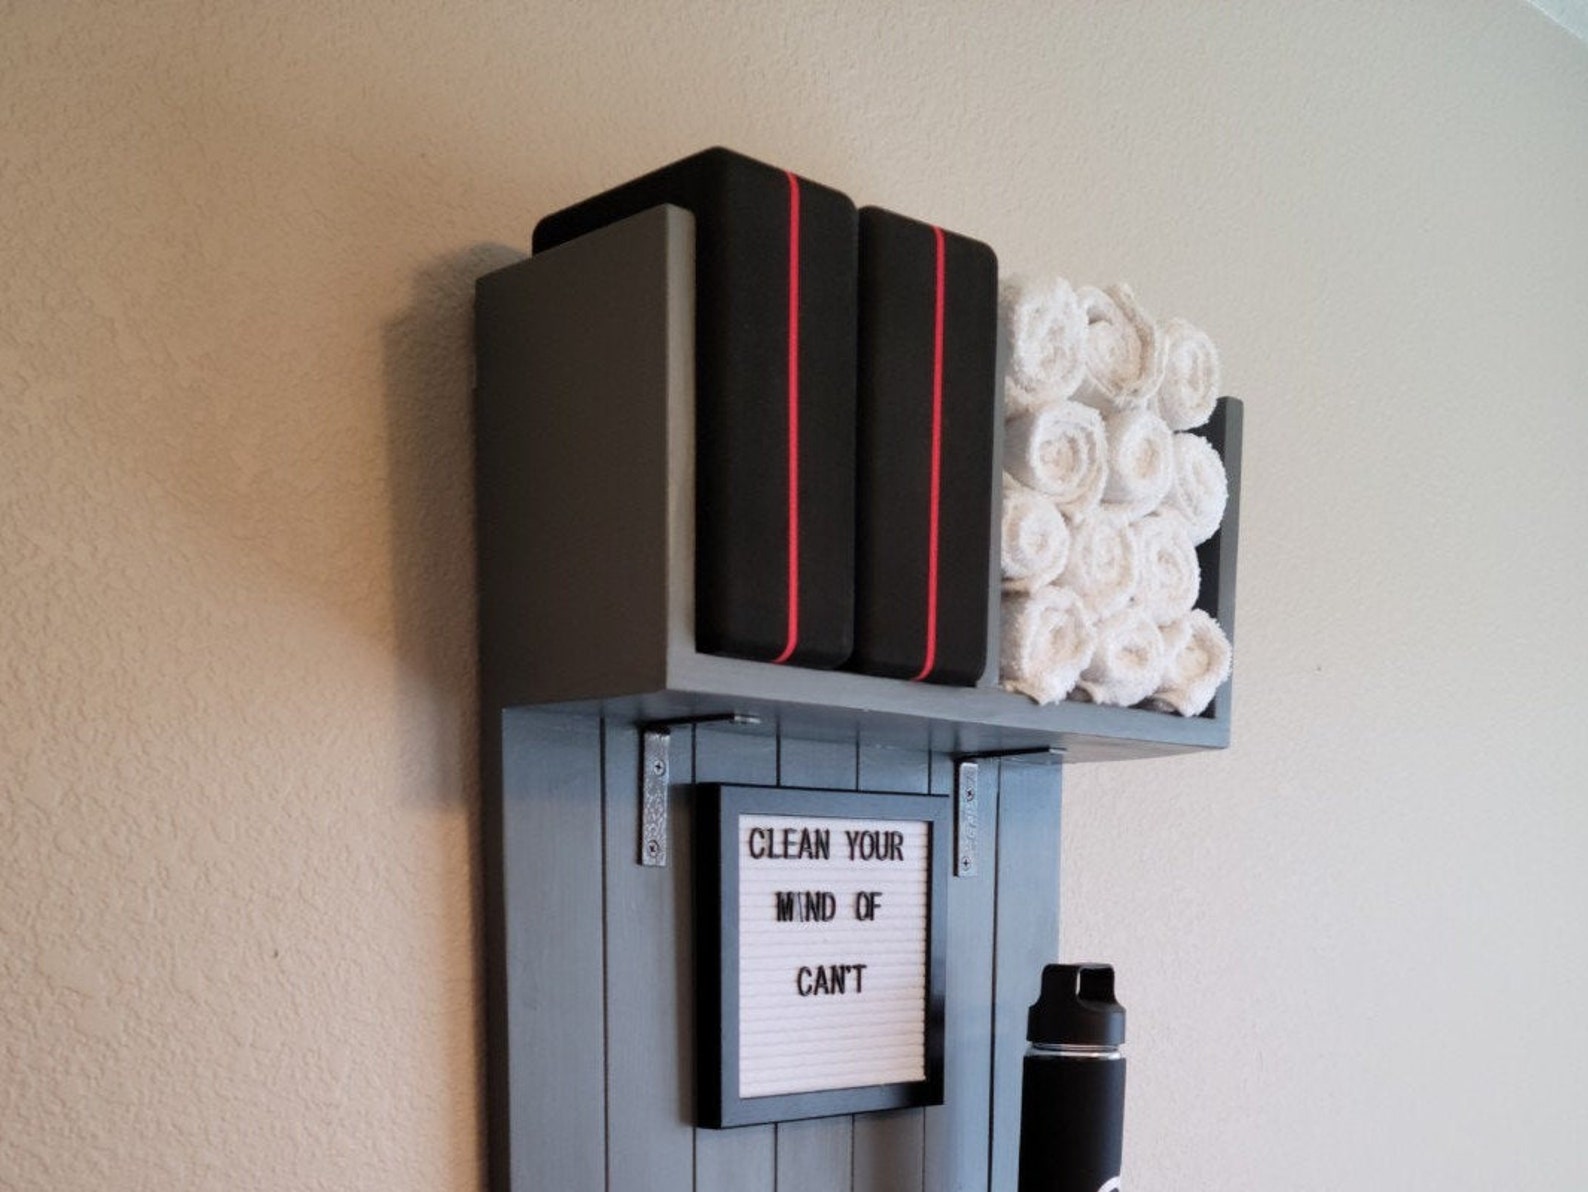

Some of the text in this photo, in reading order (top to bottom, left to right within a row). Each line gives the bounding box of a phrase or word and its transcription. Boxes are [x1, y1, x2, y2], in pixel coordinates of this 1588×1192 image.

[749, 827, 904, 861] CLEAN YOUR
[775, 891, 883, 922] MIND OF
[797, 964, 867, 996] CAN'T
